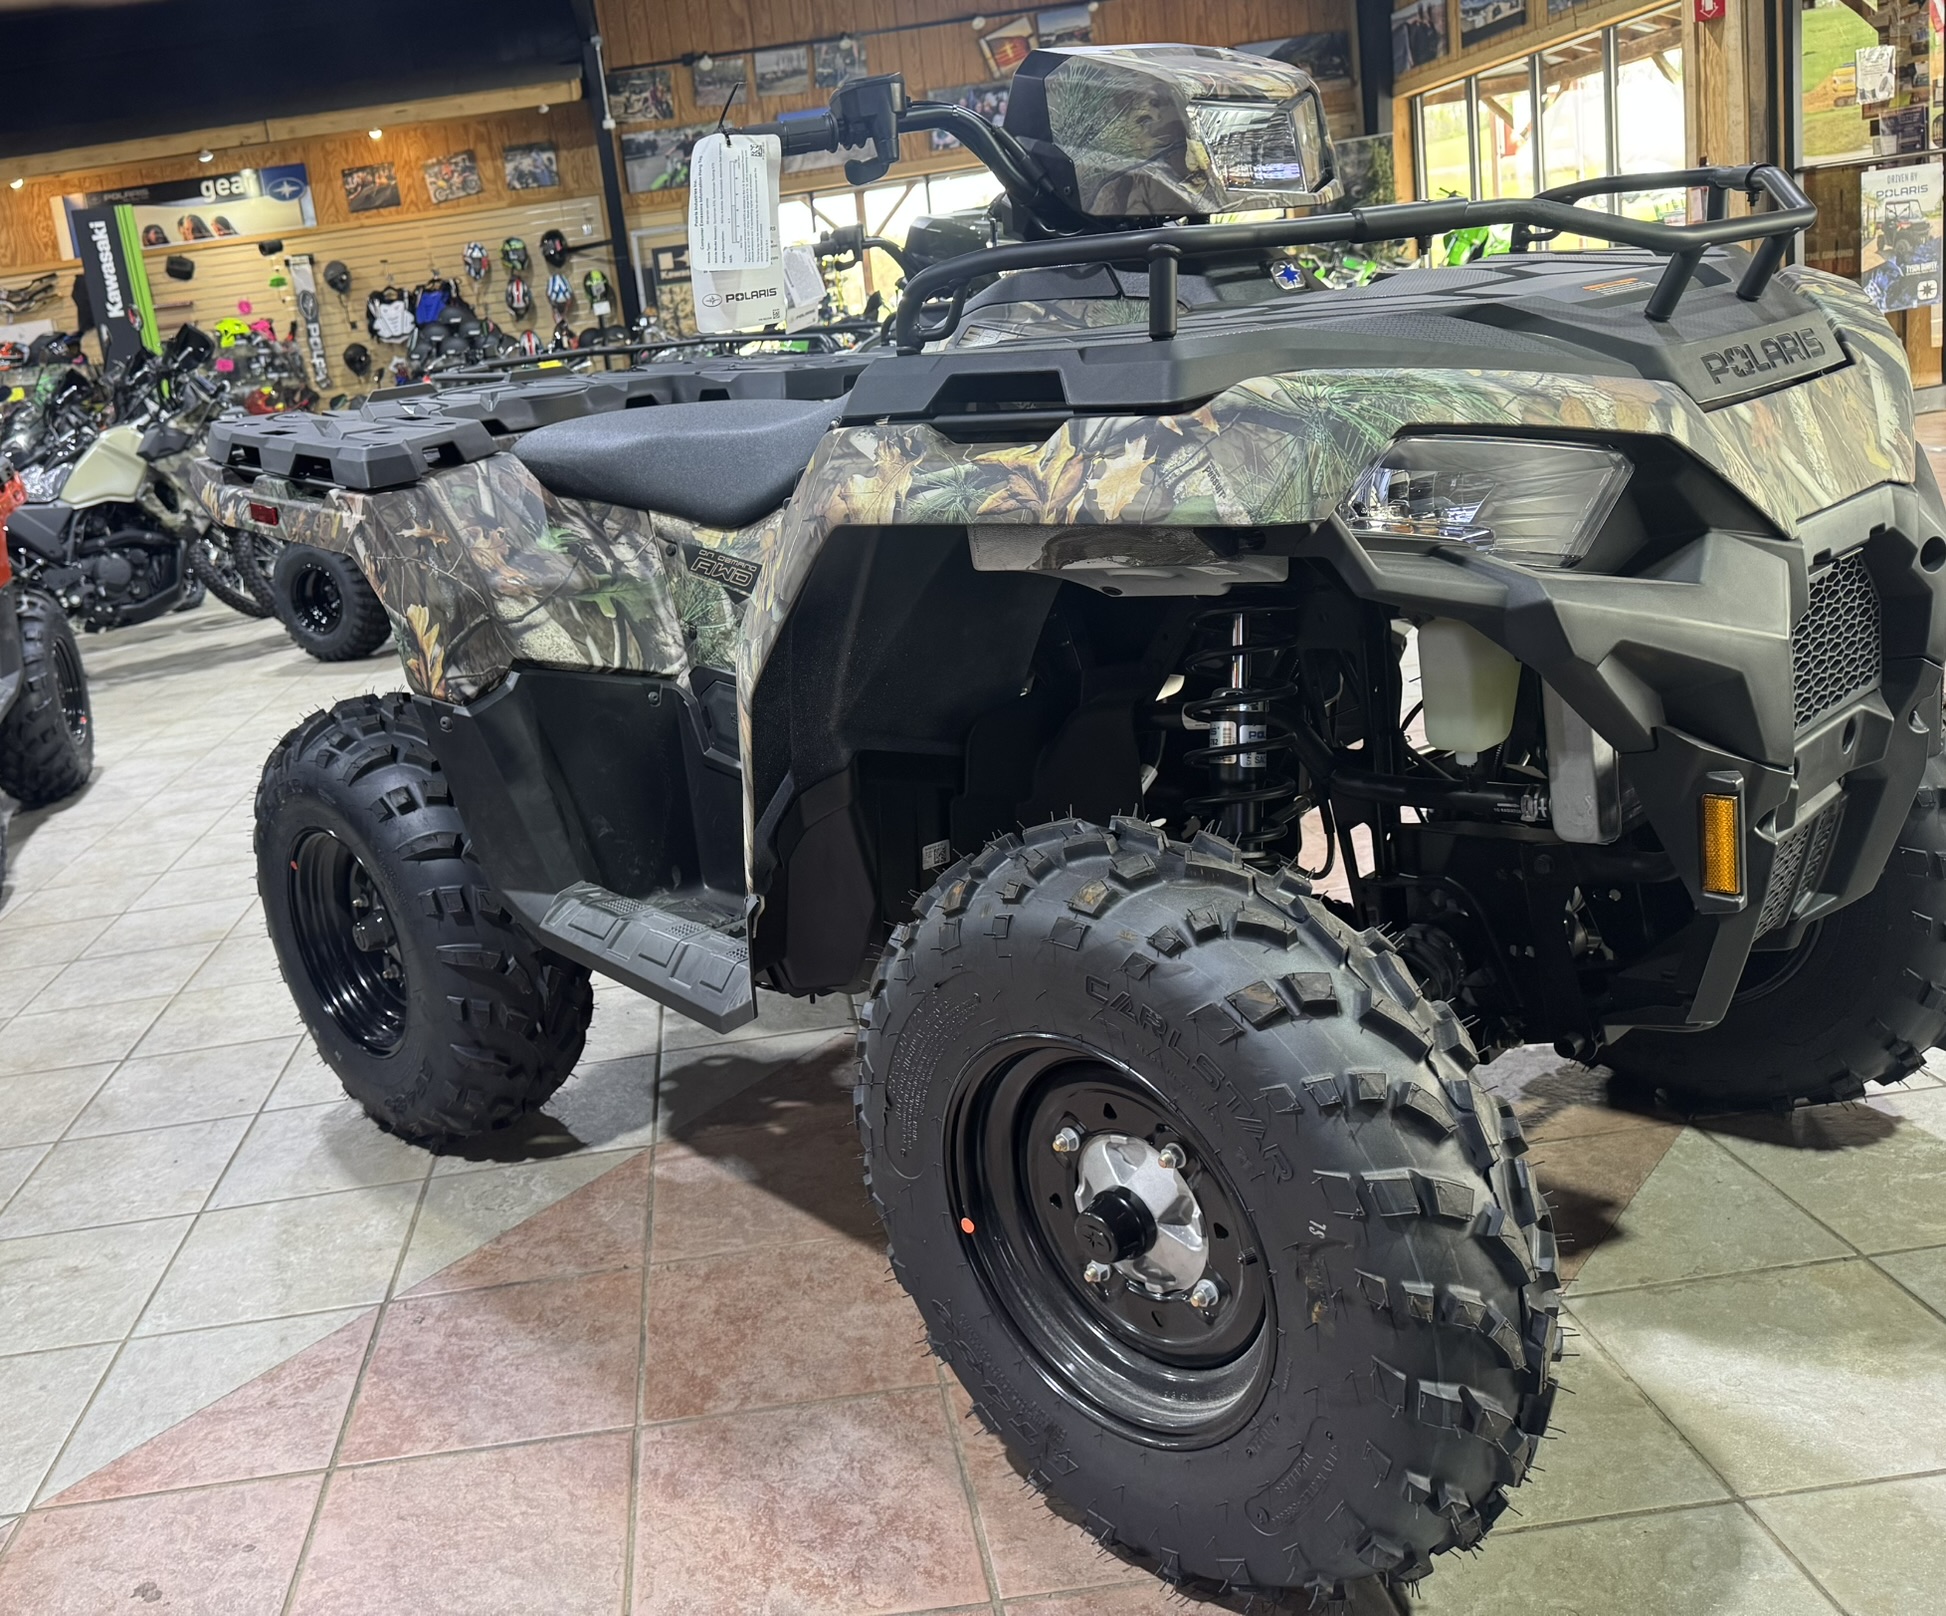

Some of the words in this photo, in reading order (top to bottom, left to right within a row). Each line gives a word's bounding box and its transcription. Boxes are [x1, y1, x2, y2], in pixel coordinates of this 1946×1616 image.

[1886, 172, 1909, 184] DRIVEN
[1910, 171, 1919, 182] BY
[1875, 184, 1928, 200] POLARIS
[88, 220, 125, 318] Kawasaki
[725, 287, 777, 303] POLARIS
[1700, 327, 1826, 385] POLARIS
[698, 549, 715, 559] ON
[690, 556, 753, 587] AWD
[1085, 974, 1294, 1185] CARLSTAR
